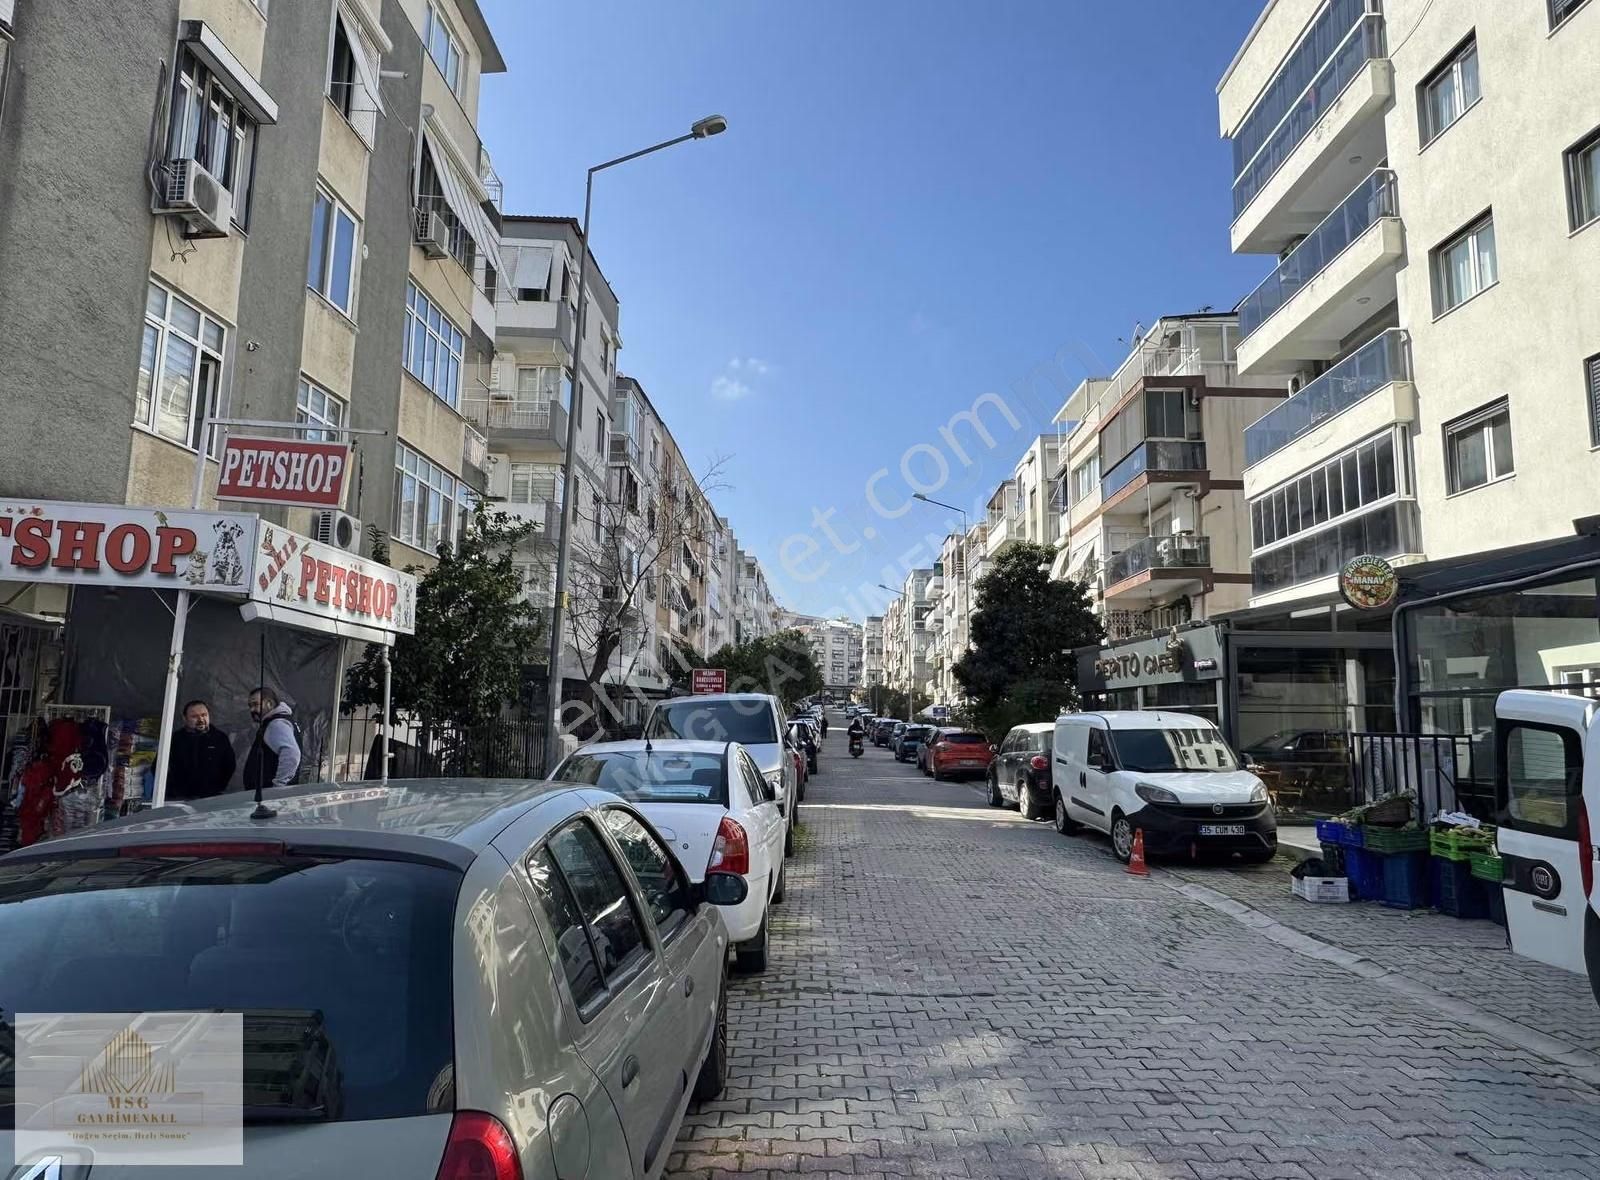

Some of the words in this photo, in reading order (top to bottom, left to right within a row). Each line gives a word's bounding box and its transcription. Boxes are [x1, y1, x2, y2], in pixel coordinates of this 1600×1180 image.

[220, 446, 344, 494] PETSHOP
[0, 516, 197, 575] SHOP
[297, 553, 398, 619] PETSHOP
[1353, 576, 1385, 585] MANAV
[1202, 826, 1212, 834] 35
[1231, 826, 1244, 834] 430
